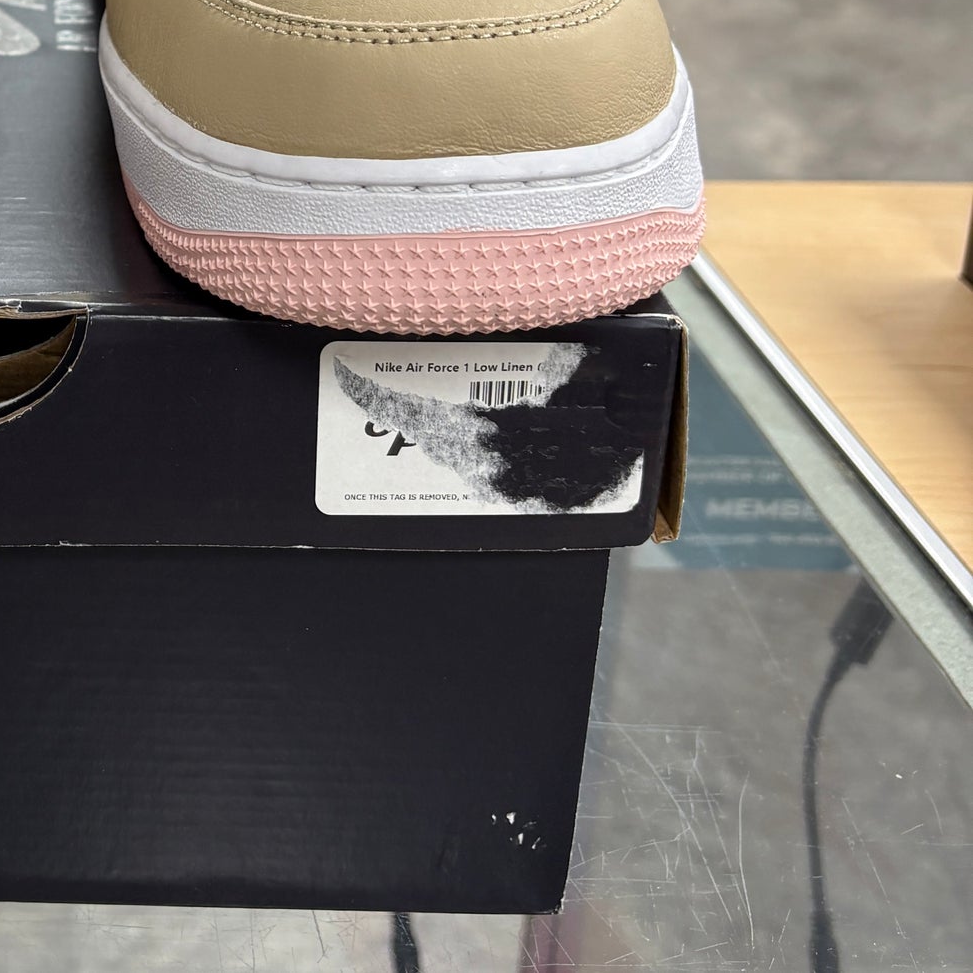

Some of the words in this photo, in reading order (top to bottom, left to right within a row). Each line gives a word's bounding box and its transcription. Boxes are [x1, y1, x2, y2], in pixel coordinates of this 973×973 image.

[375, 362, 403, 373] Nike
[406, 362, 424, 373] Air
[427, 362, 460, 373] Force
[463, 362, 469, 373] 1
[474, 362, 499, 373] Low
[501, 362, 533, 373] Linen
[419, 494, 459, 502] REMOVED,
